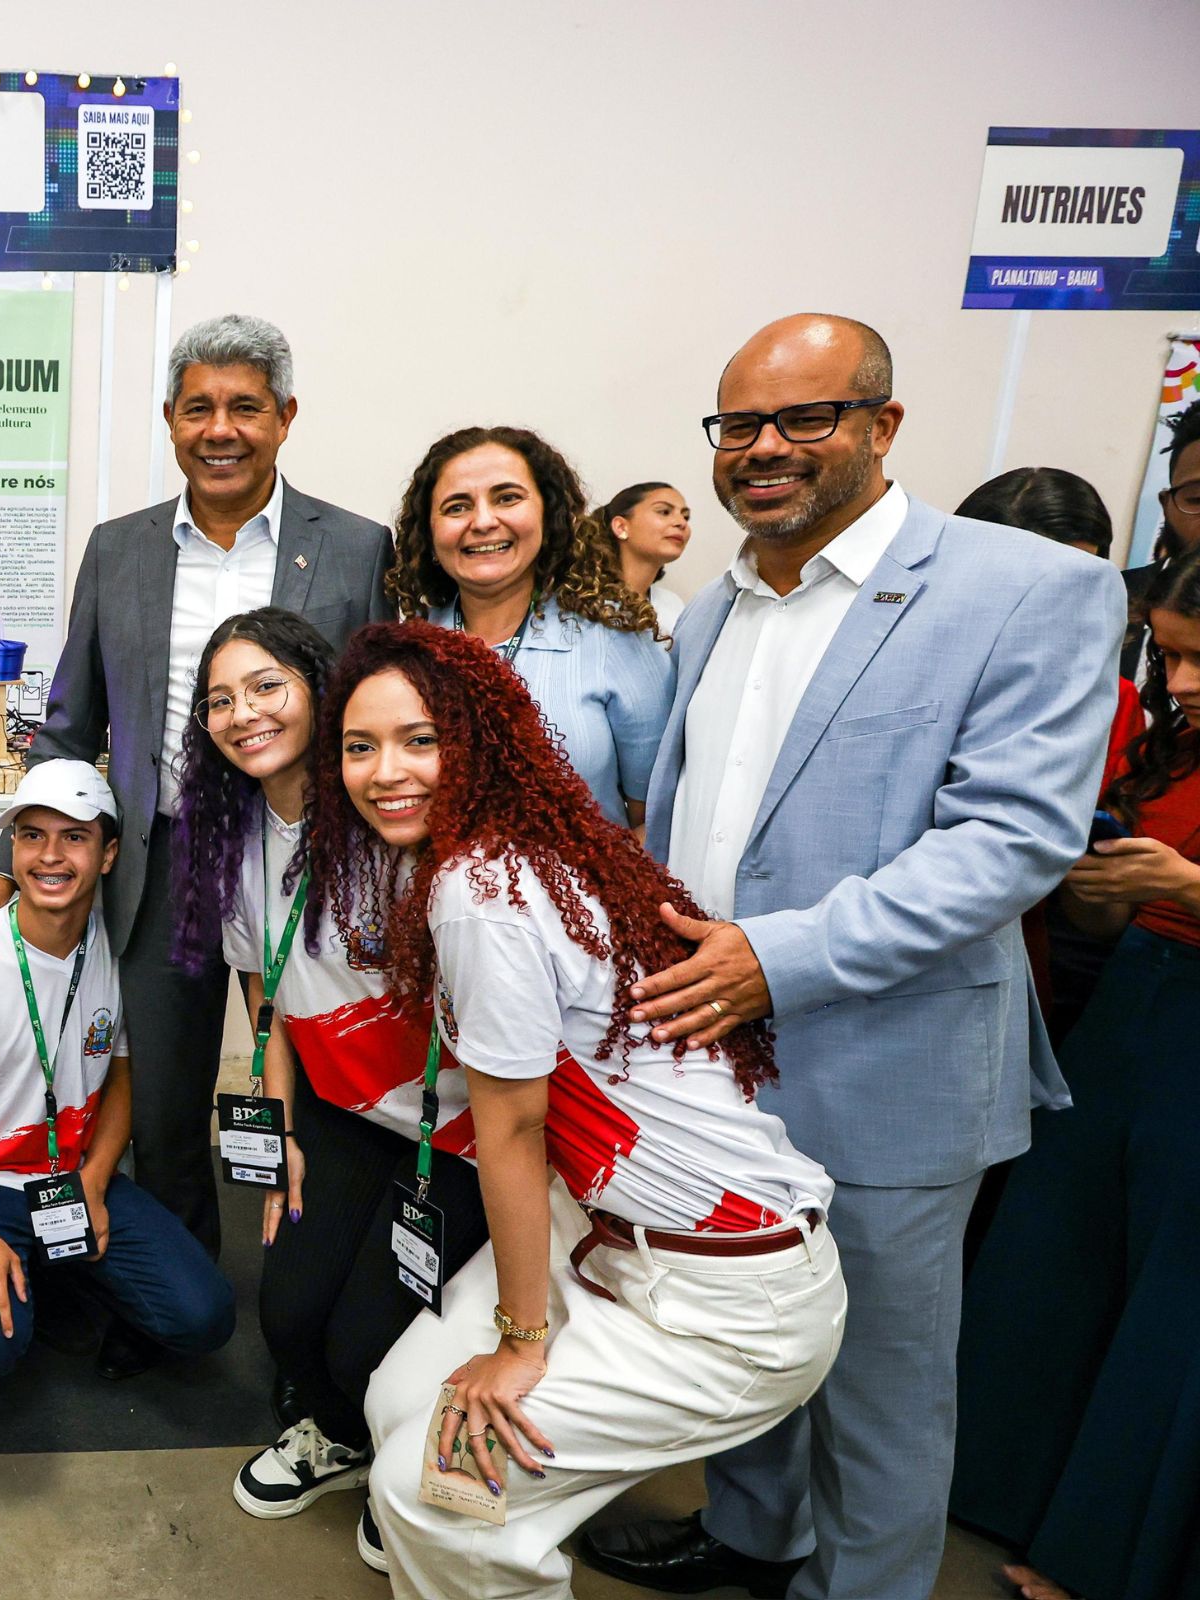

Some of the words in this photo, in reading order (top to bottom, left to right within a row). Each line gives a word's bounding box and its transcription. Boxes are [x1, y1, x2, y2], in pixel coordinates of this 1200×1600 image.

[83, 111, 106, 125] SAIBA
[108, 111, 129, 125] MAIS
[132, 112, 150, 126] AQUI
[1001, 185, 1146, 224] NUTRIAVES
[991, 270, 1058, 286] PLANALTINHO
[1067, 270, 1098, 286] BAHIA
[24, 475, 55, 488] nós
[232, 1106, 260, 1122] BTX
[38, 1186, 64, 1203] BTX
